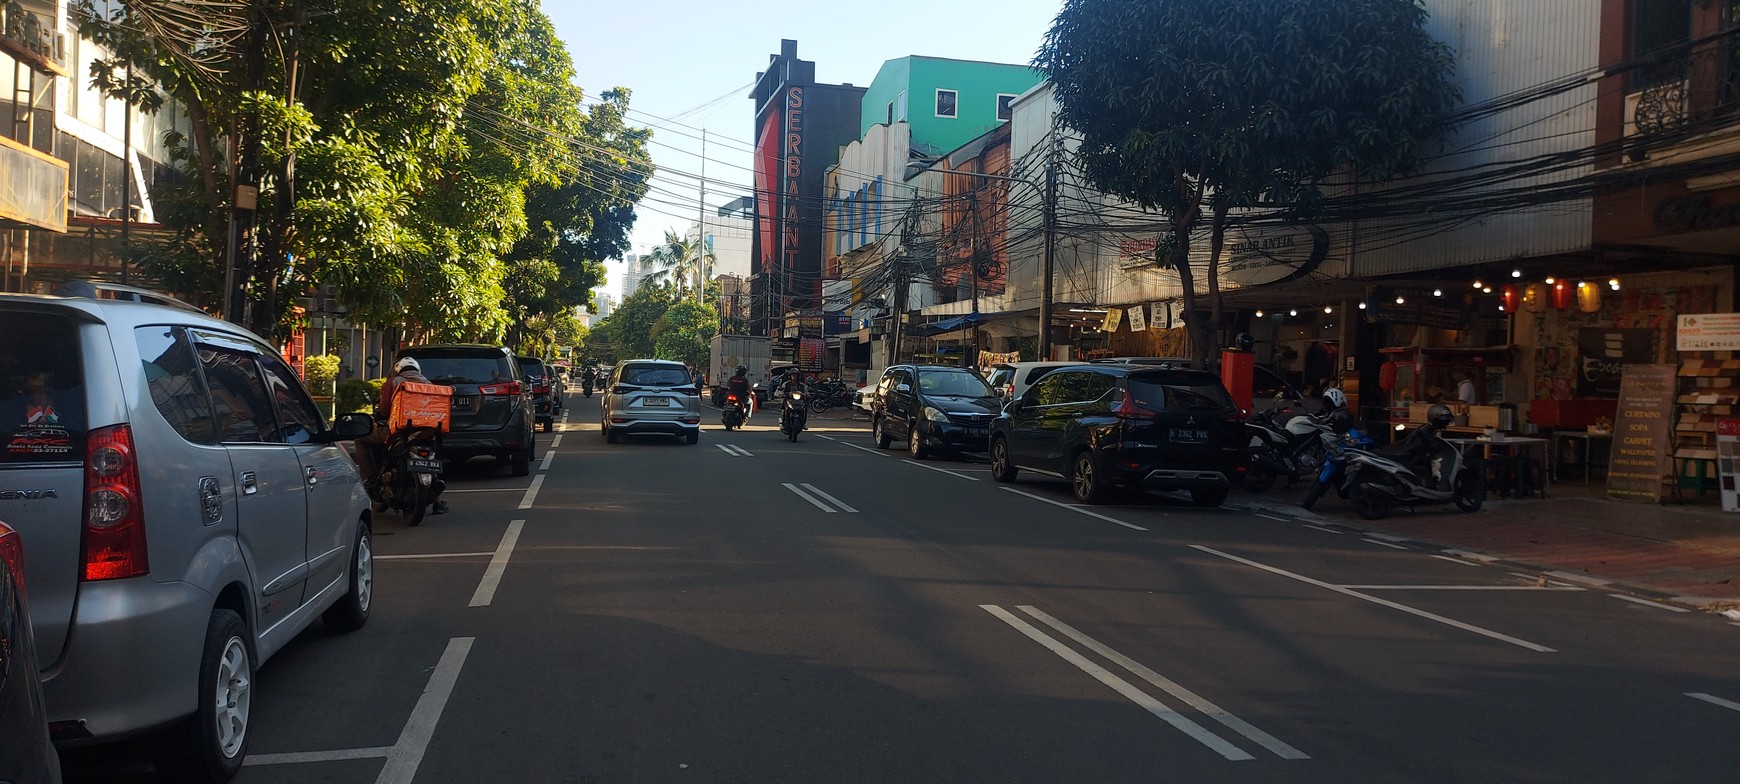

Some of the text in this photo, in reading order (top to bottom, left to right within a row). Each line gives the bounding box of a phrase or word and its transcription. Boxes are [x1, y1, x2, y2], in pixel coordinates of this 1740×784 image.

[788, 87, 803, 200] SERBA
[1231, 234, 1294, 255] SINAR ANTIK
[1629, 424, 1648, 432] SOFA
[1624, 437, 1652, 445] CARPET
[1620, 448, 1657, 456] WALLPAPER
